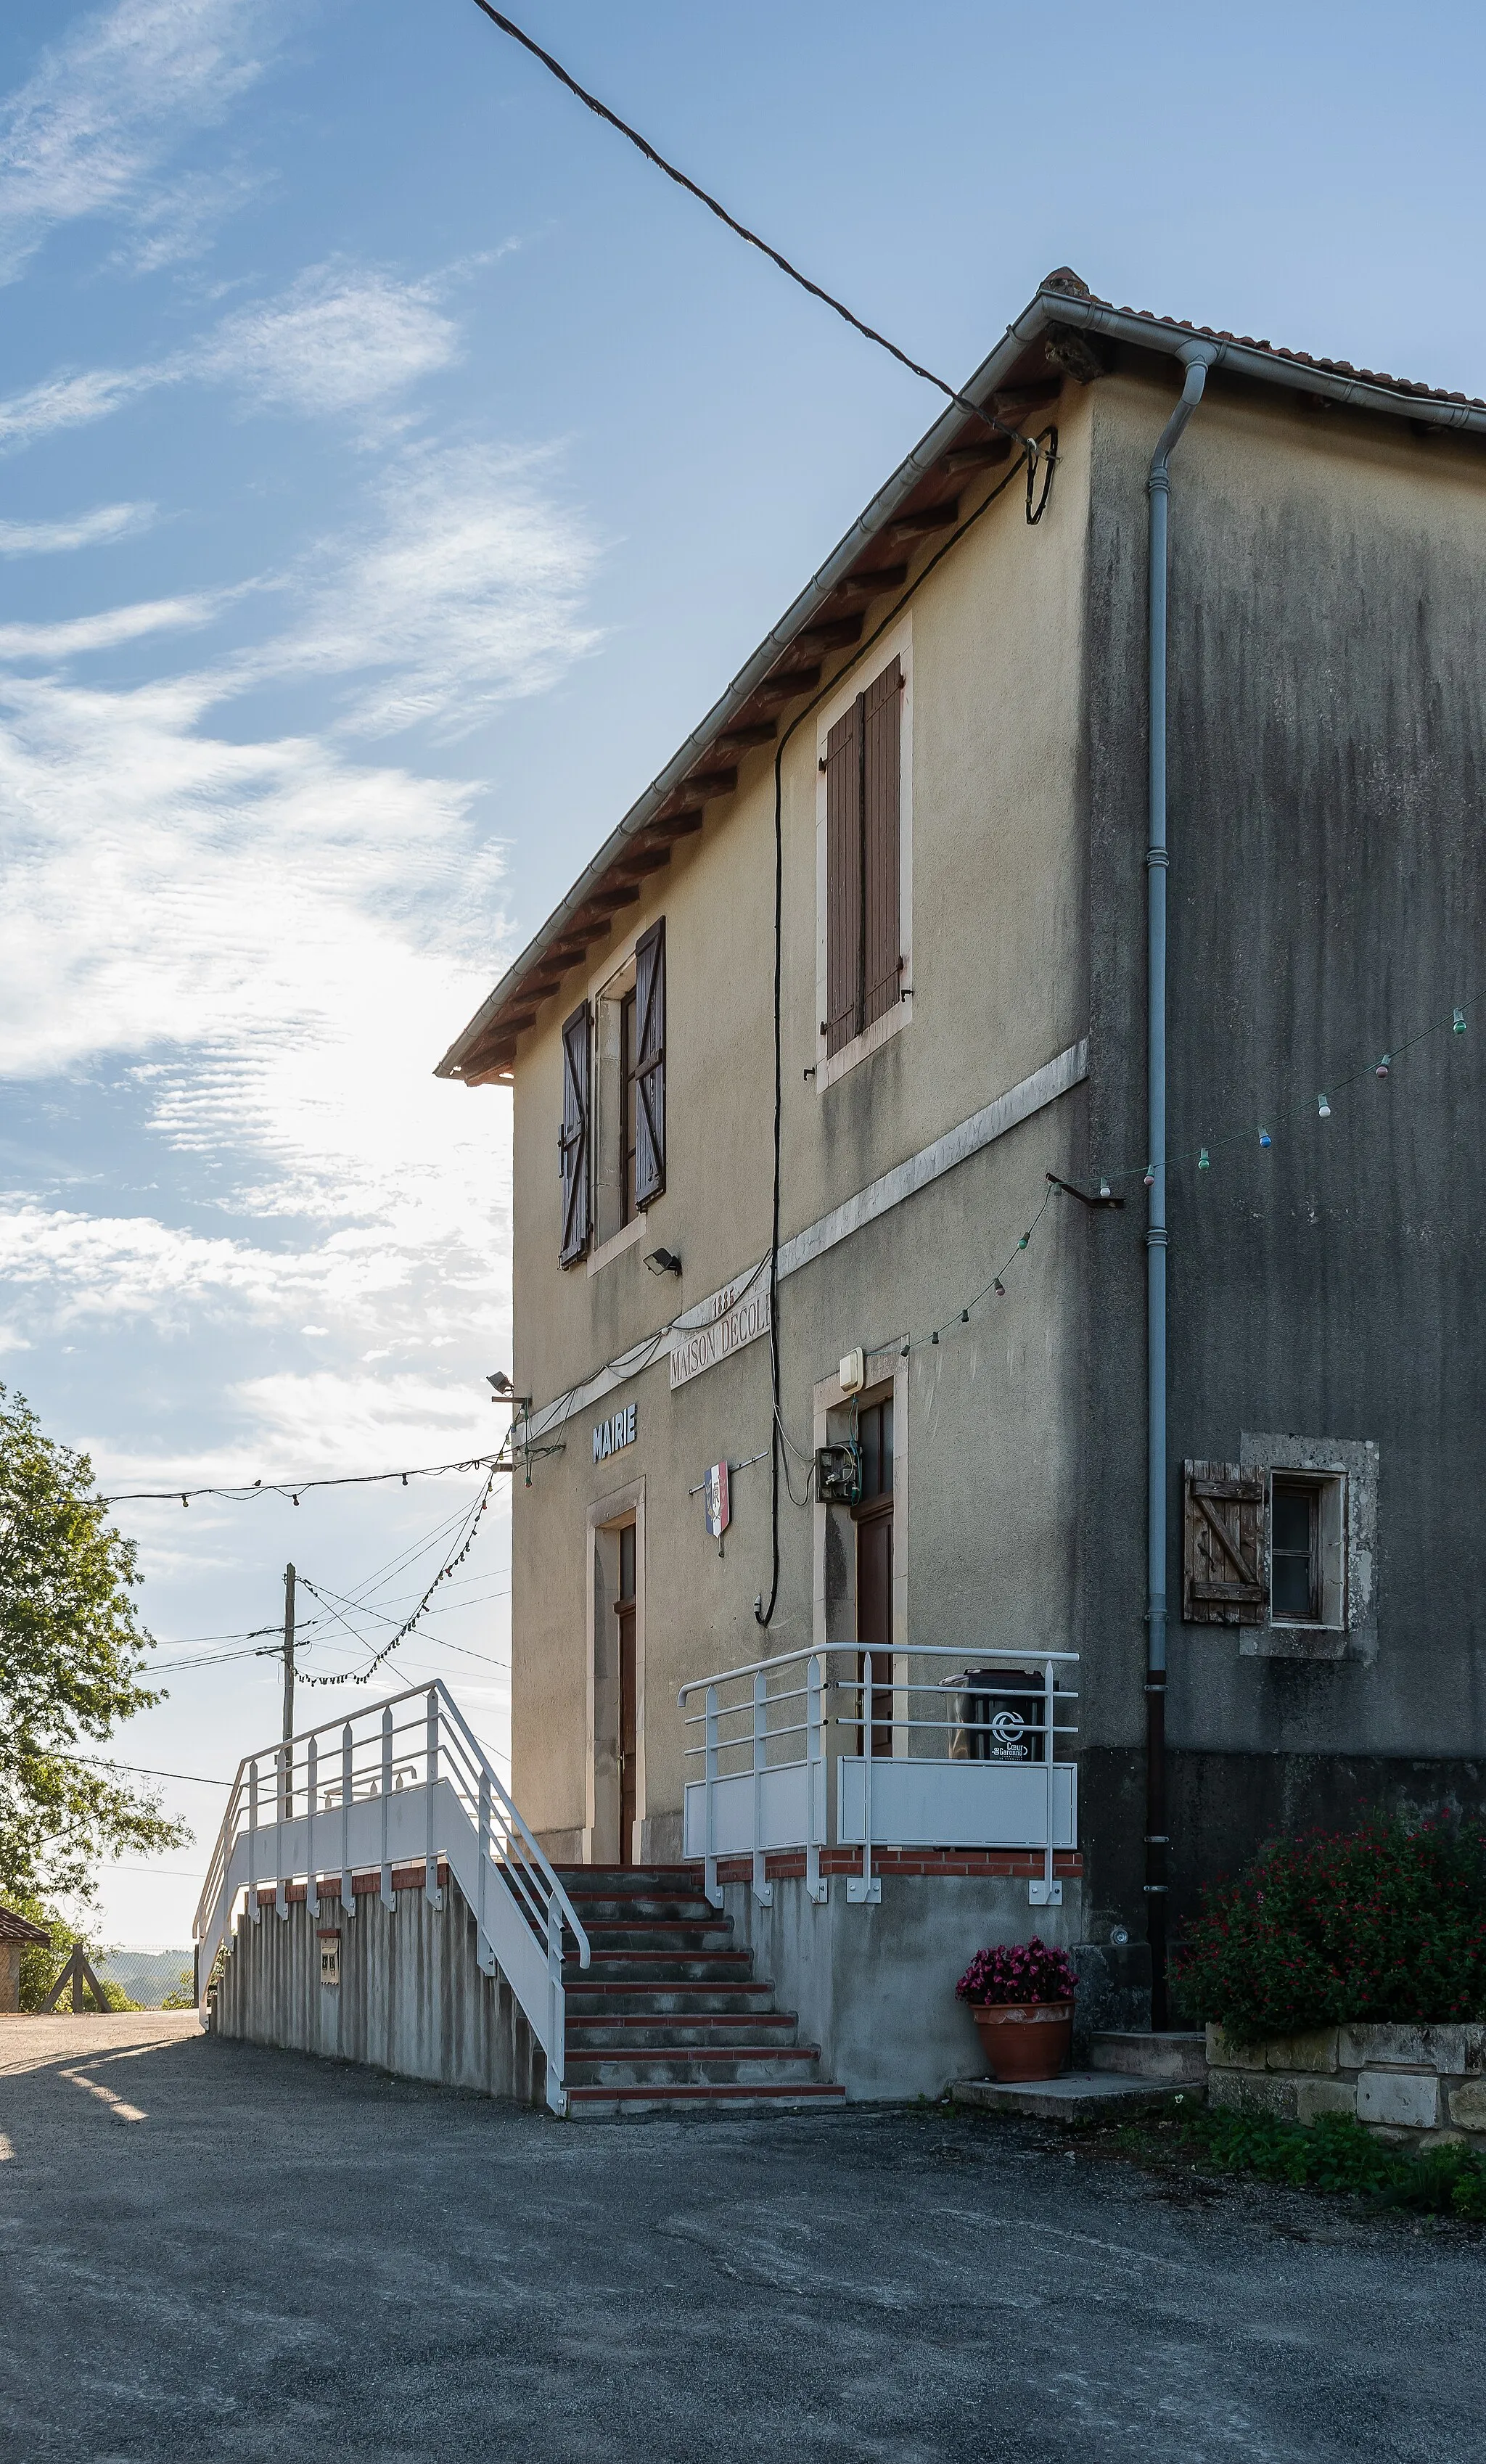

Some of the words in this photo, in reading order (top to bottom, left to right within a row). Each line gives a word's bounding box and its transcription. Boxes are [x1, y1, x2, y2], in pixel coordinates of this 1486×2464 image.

[671, 1327, 718, 1384] MAISON
[593, 1403, 636, 1463] MAIRIE
[1007, 1742, 1023, 1751] Cœur
